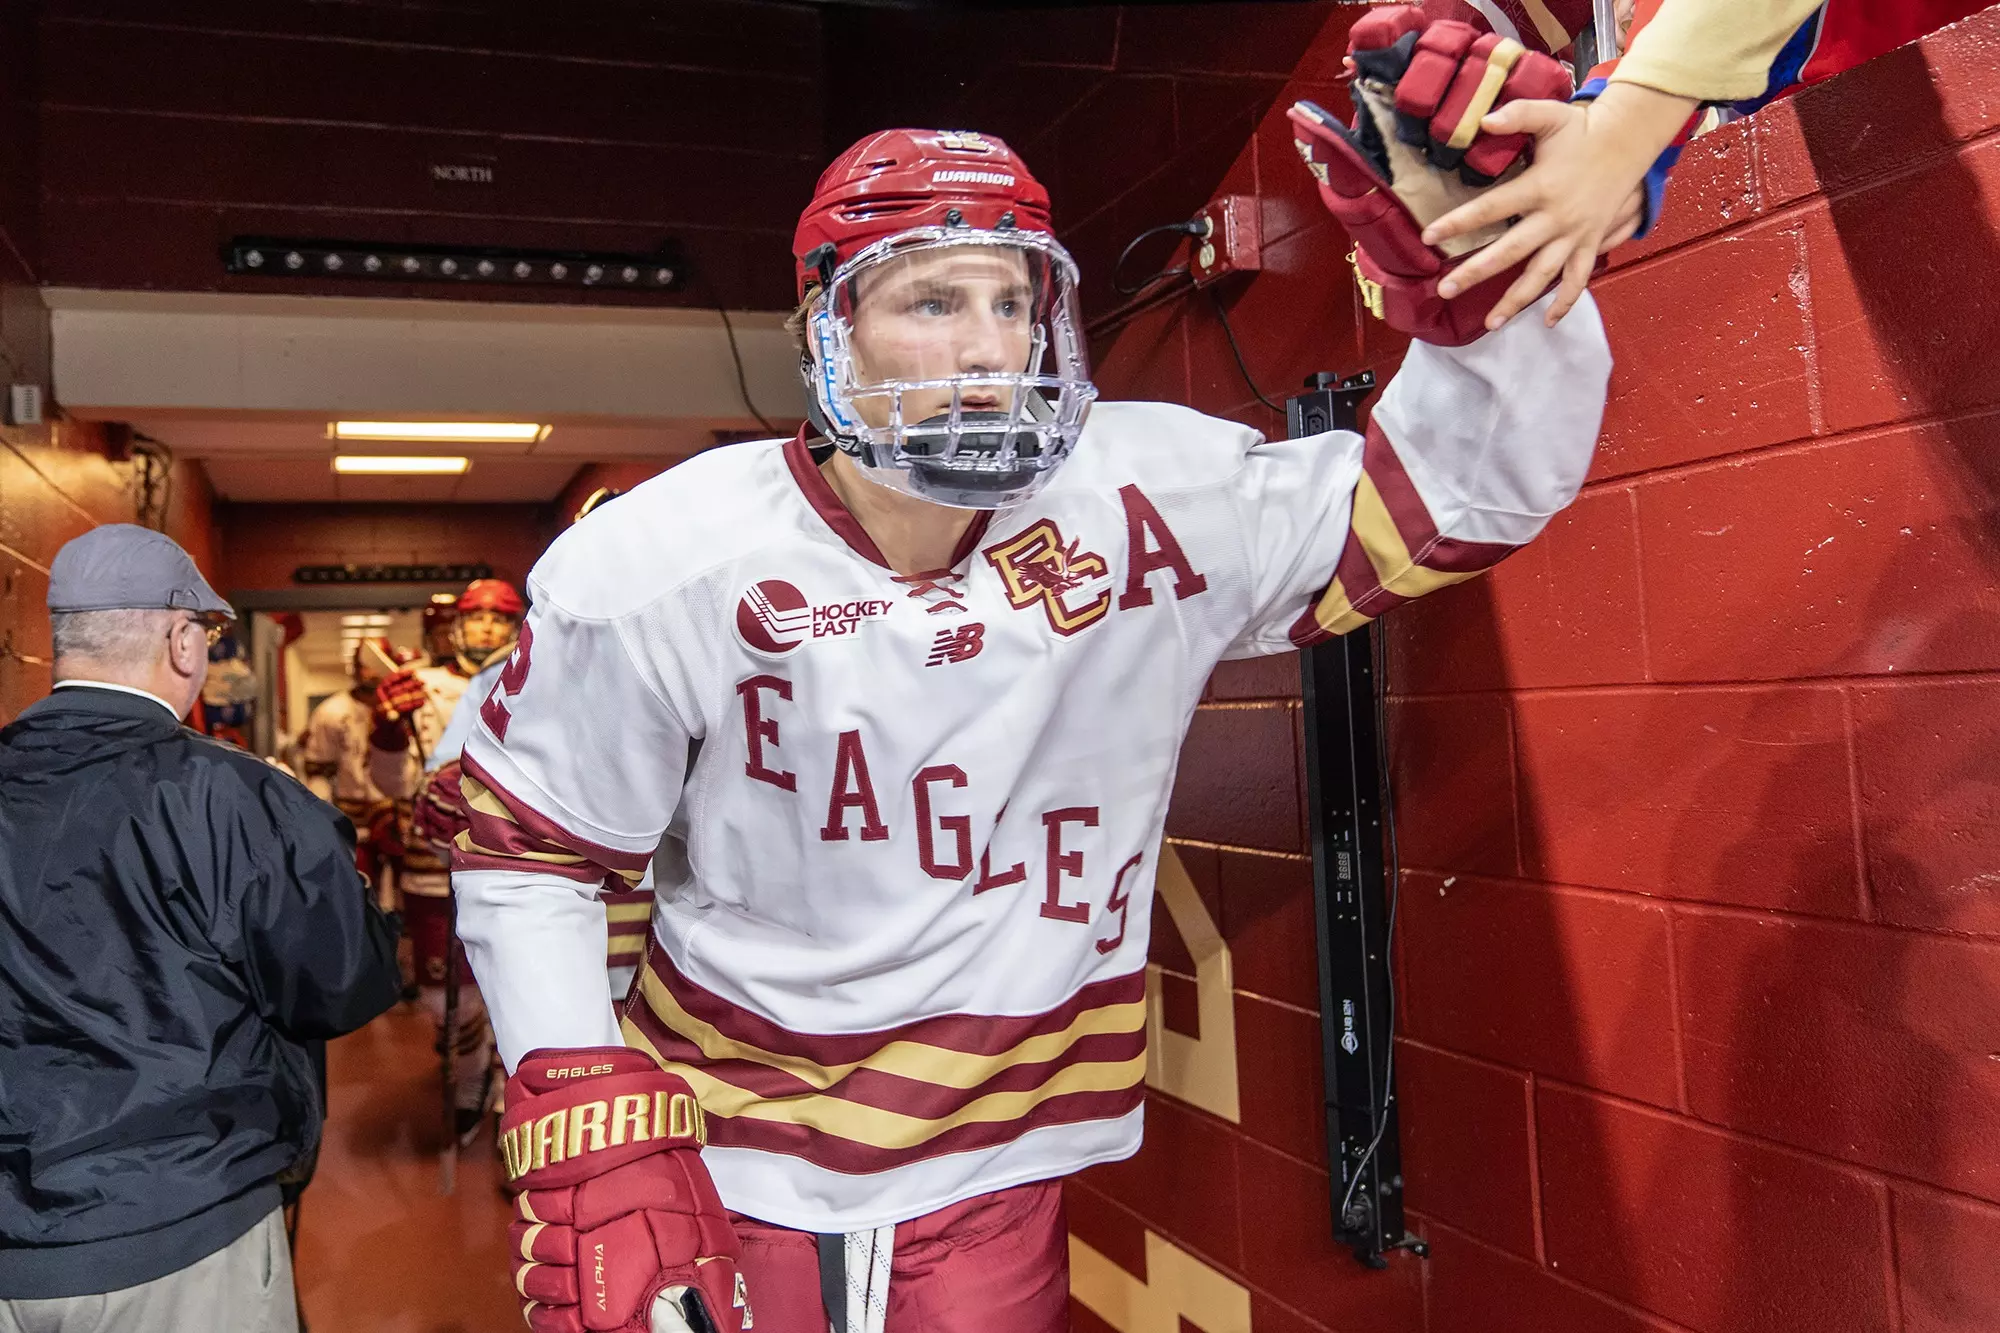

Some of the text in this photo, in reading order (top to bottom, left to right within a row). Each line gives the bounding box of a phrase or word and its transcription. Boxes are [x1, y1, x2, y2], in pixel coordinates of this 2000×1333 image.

[432, 165, 492, 182] NORTH
[932, 170, 1016, 187] WARRIOR
[1118, 483, 1208, 612] A
[981, 517, 1112, 638] BC
[812, 600, 893, 622] HOCKEY
[812, 618, 860, 638] EAST
[925, 622, 986, 668] NB
[736, 673, 1143, 956] EAGLES
[546, 1063, 615, 1080] EAGLES
[594, 1243, 606, 1312] ALPHA
